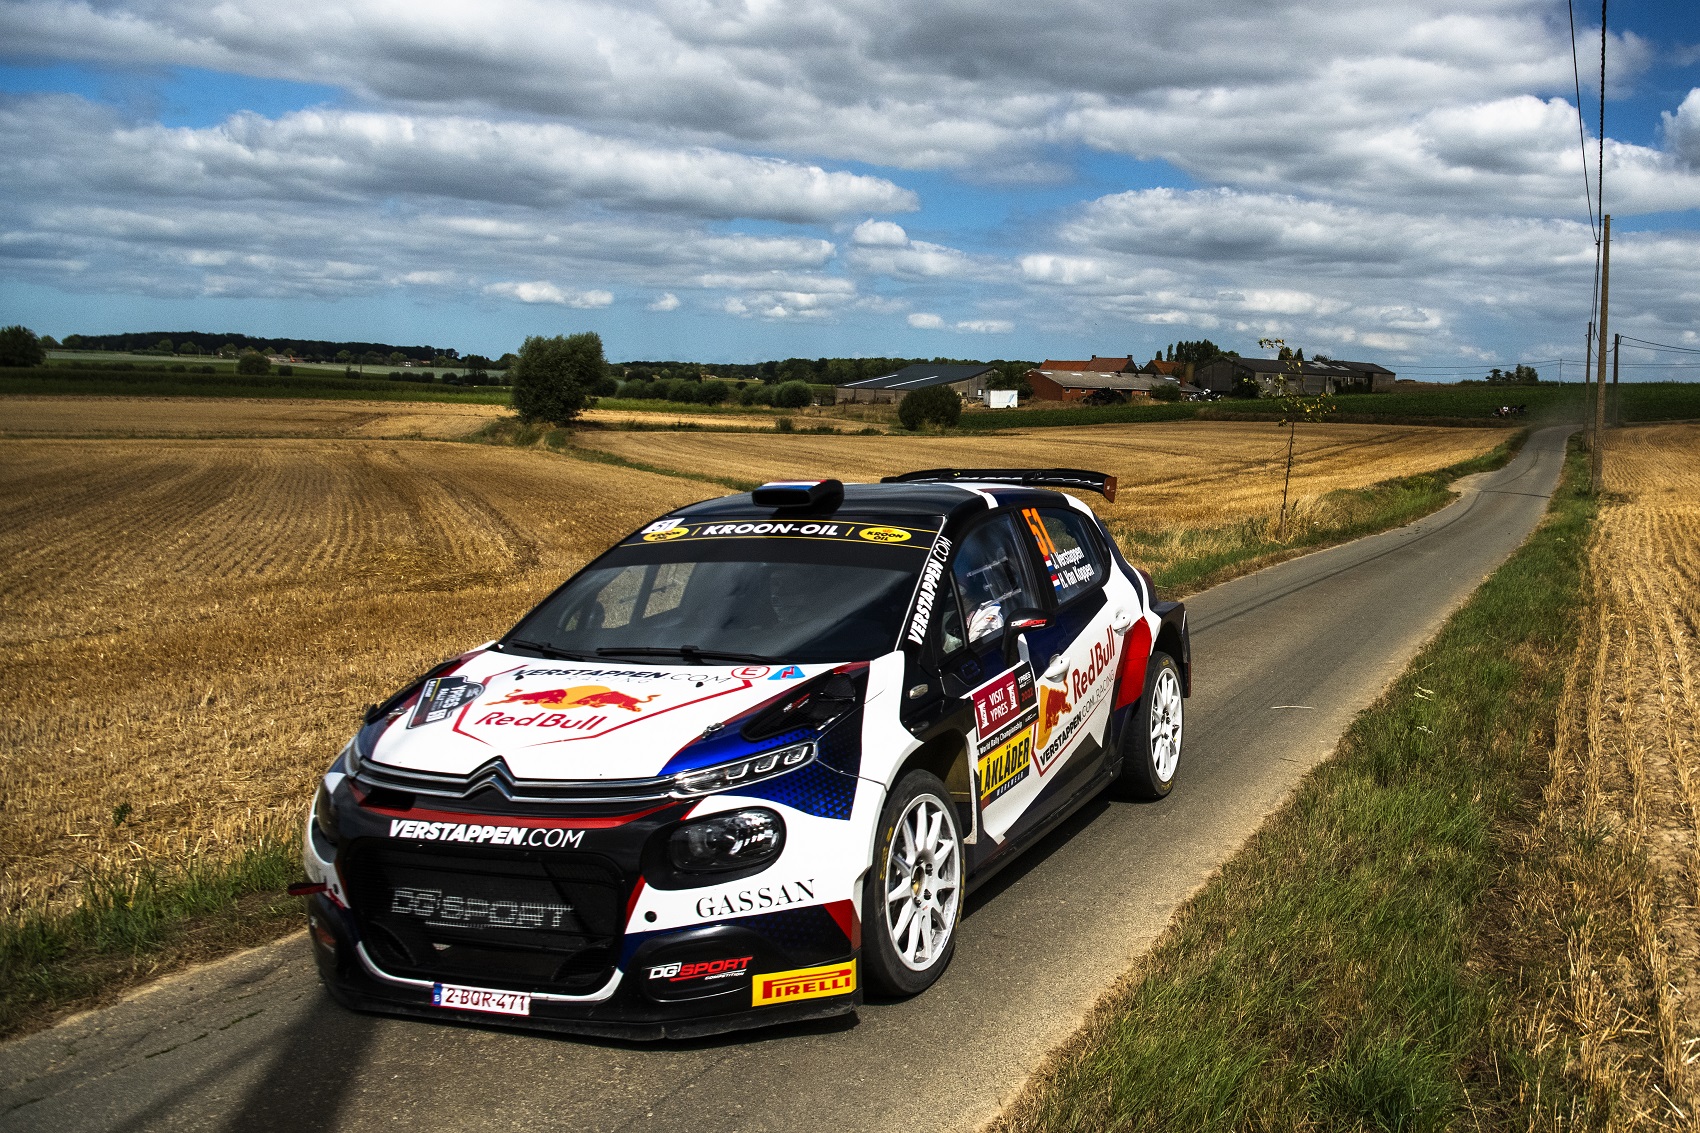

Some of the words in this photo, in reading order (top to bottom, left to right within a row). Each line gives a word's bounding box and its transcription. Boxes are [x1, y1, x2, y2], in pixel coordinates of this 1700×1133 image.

[702, 524, 839, 536] KROON-OIL
[866, 531, 904, 540] KROON
[873, 534, 889, 542] OIL
[1022, 508, 1056, 556] 51
[1063, 569, 1078, 586] Van
[513, 669, 732, 684] VERSTAPPEN.COM
[988, 687, 1005, 706] VISIT
[1021, 687, 1034, 702] 2022
[989, 701, 1009, 721] YPRES
[979, 741, 992, 755] World
[990, 736, 1000, 749] Rally
[980, 737, 1030, 794] LÅKLÄDER
[388, 819, 586, 849] VERSTAPPEN.COM
[695, 878, 816, 919] GASSAN
[762, 968, 853, 1000] PIRELLI
